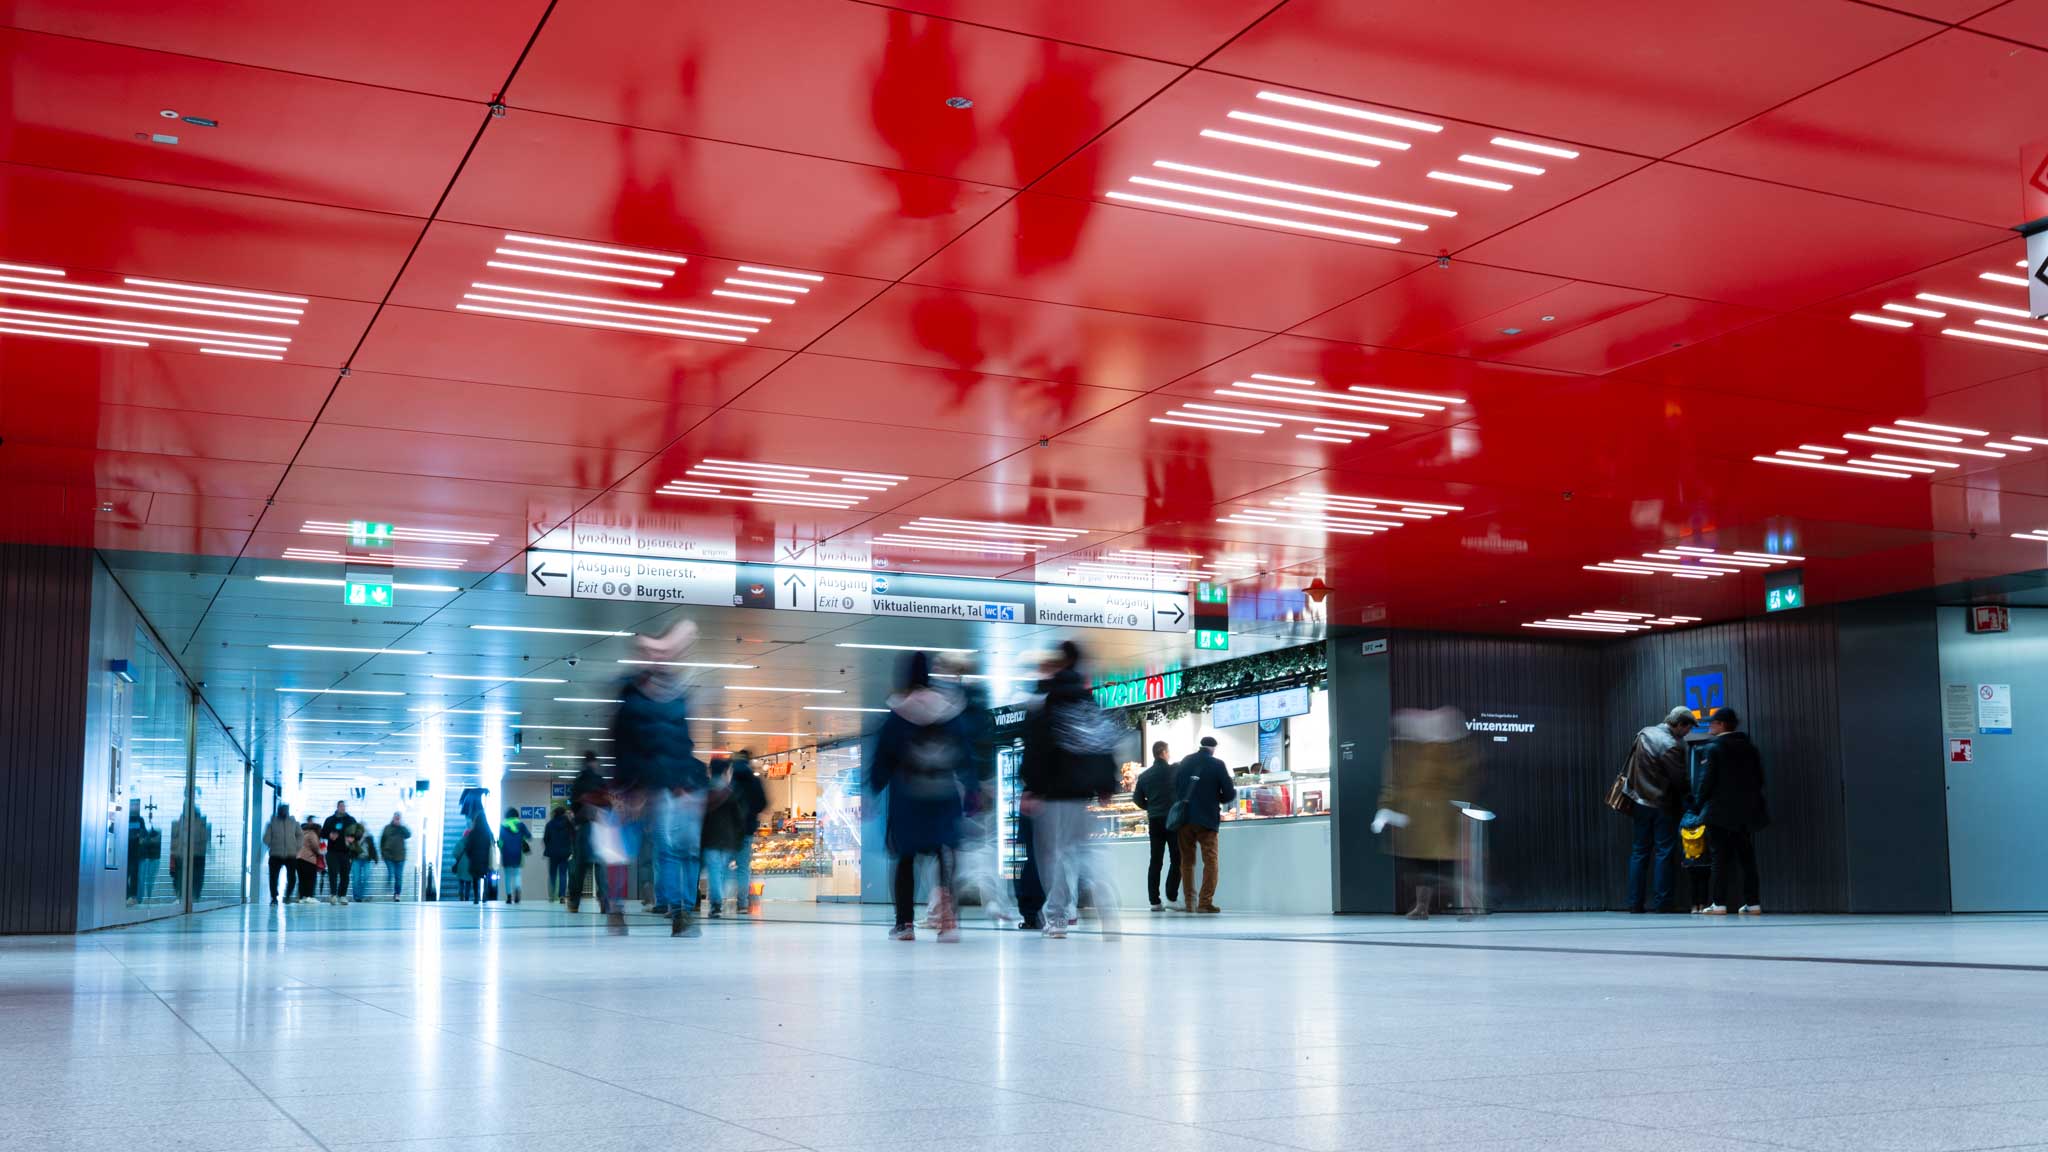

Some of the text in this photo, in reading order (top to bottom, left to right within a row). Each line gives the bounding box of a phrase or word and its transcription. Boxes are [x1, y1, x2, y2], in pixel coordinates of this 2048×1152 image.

[577, 560, 697, 580] Ausgang Dienerstr.
[577, 581, 598, 595] Exit
[636, 585, 685, 601] Burgstr.
[818, 576, 868, 592] Ausgang
[818, 596, 838, 609] Exit
[873, 600, 982, 617] Viktualienmarkt, Tal
[1106, 594, 1150, 610] Ausgang
[985, 607, 998, 616] WC
[1039, 610, 1104, 625] Rindermarkt
[1106, 613, 1124, 626] Exit
[1465, 718, 1535, 733] vinzenzmurr
